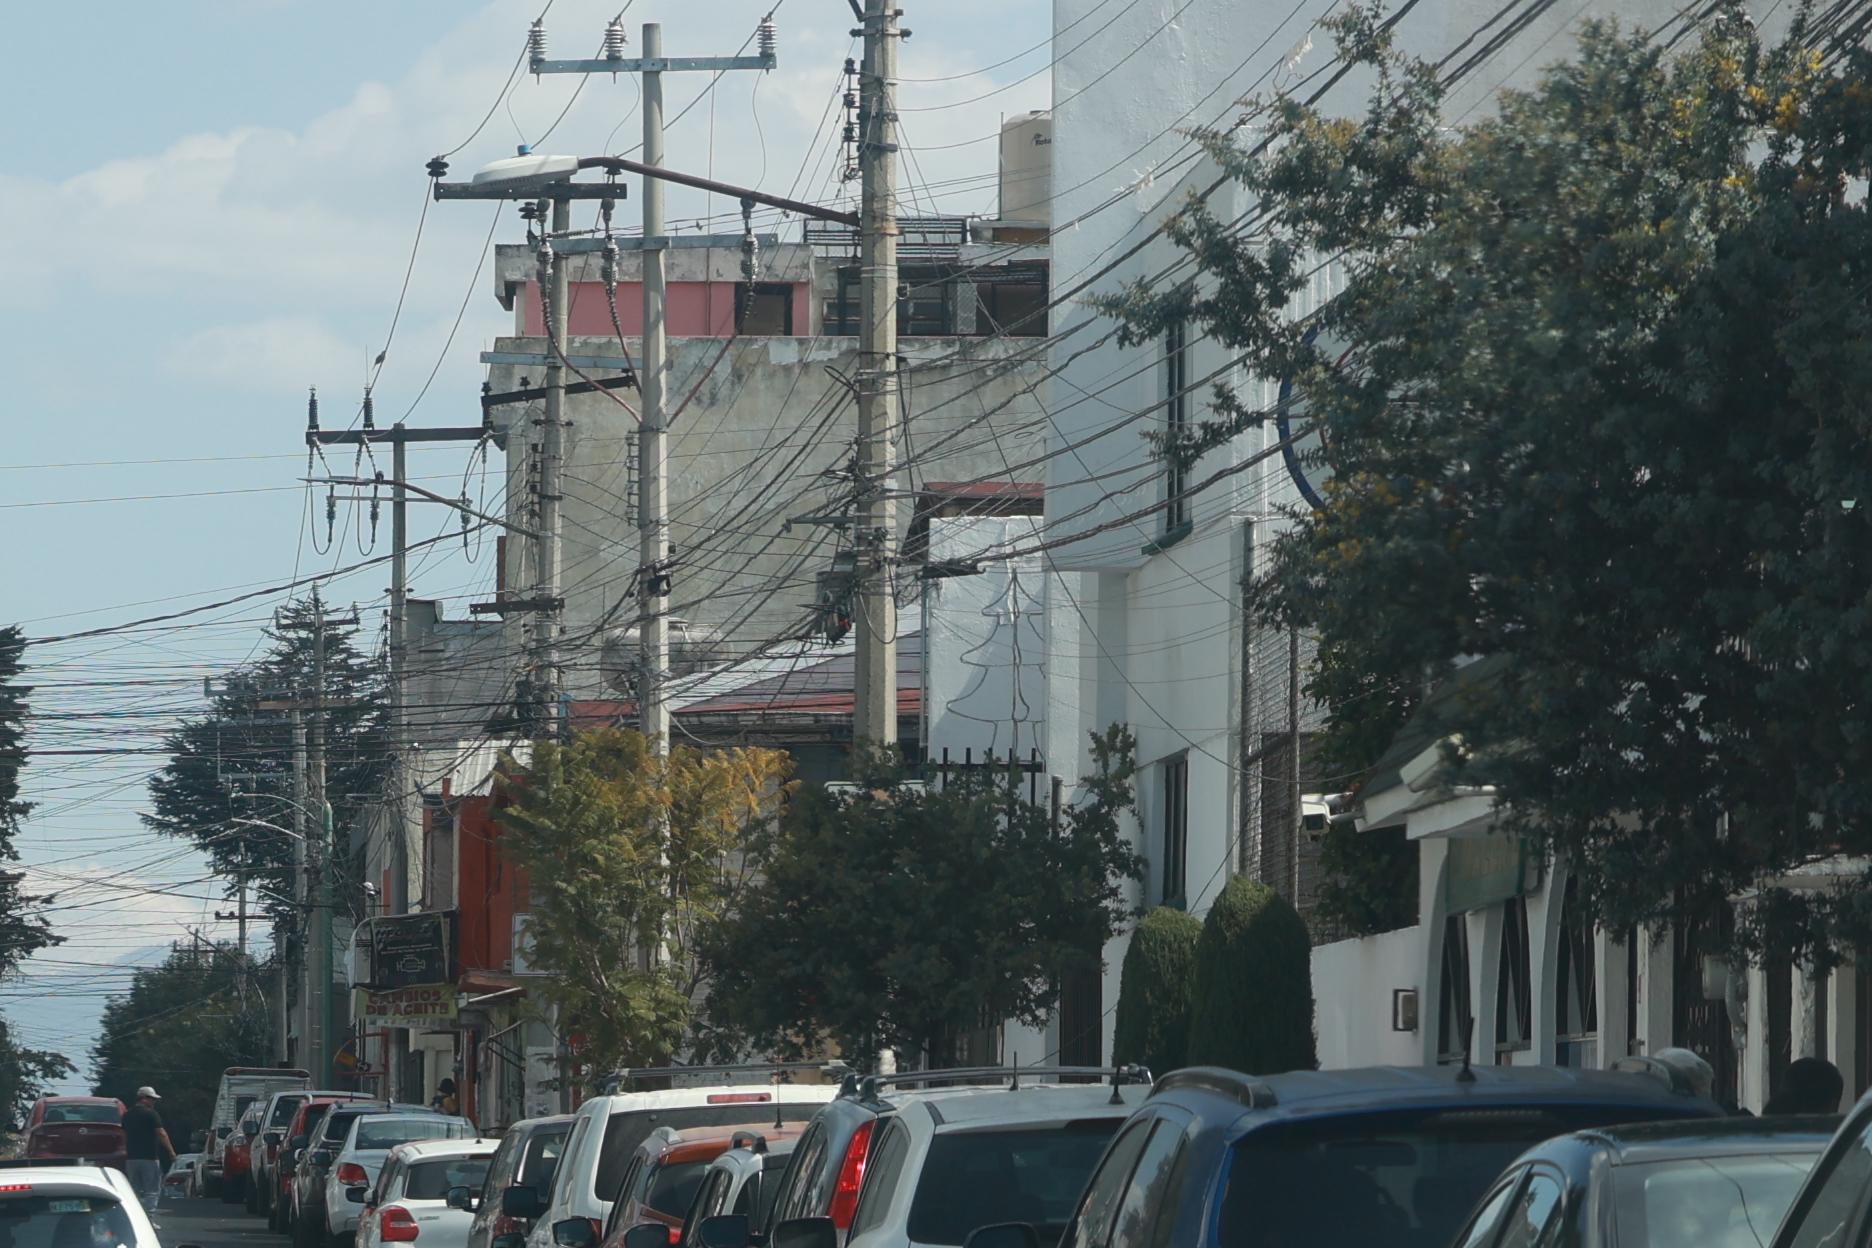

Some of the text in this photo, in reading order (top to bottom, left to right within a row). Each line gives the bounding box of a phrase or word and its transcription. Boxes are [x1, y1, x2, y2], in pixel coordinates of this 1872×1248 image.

[368, 989, 441, 1004] CAMBIOS
[366, 1002, 449, 1016] DE ACEITE
